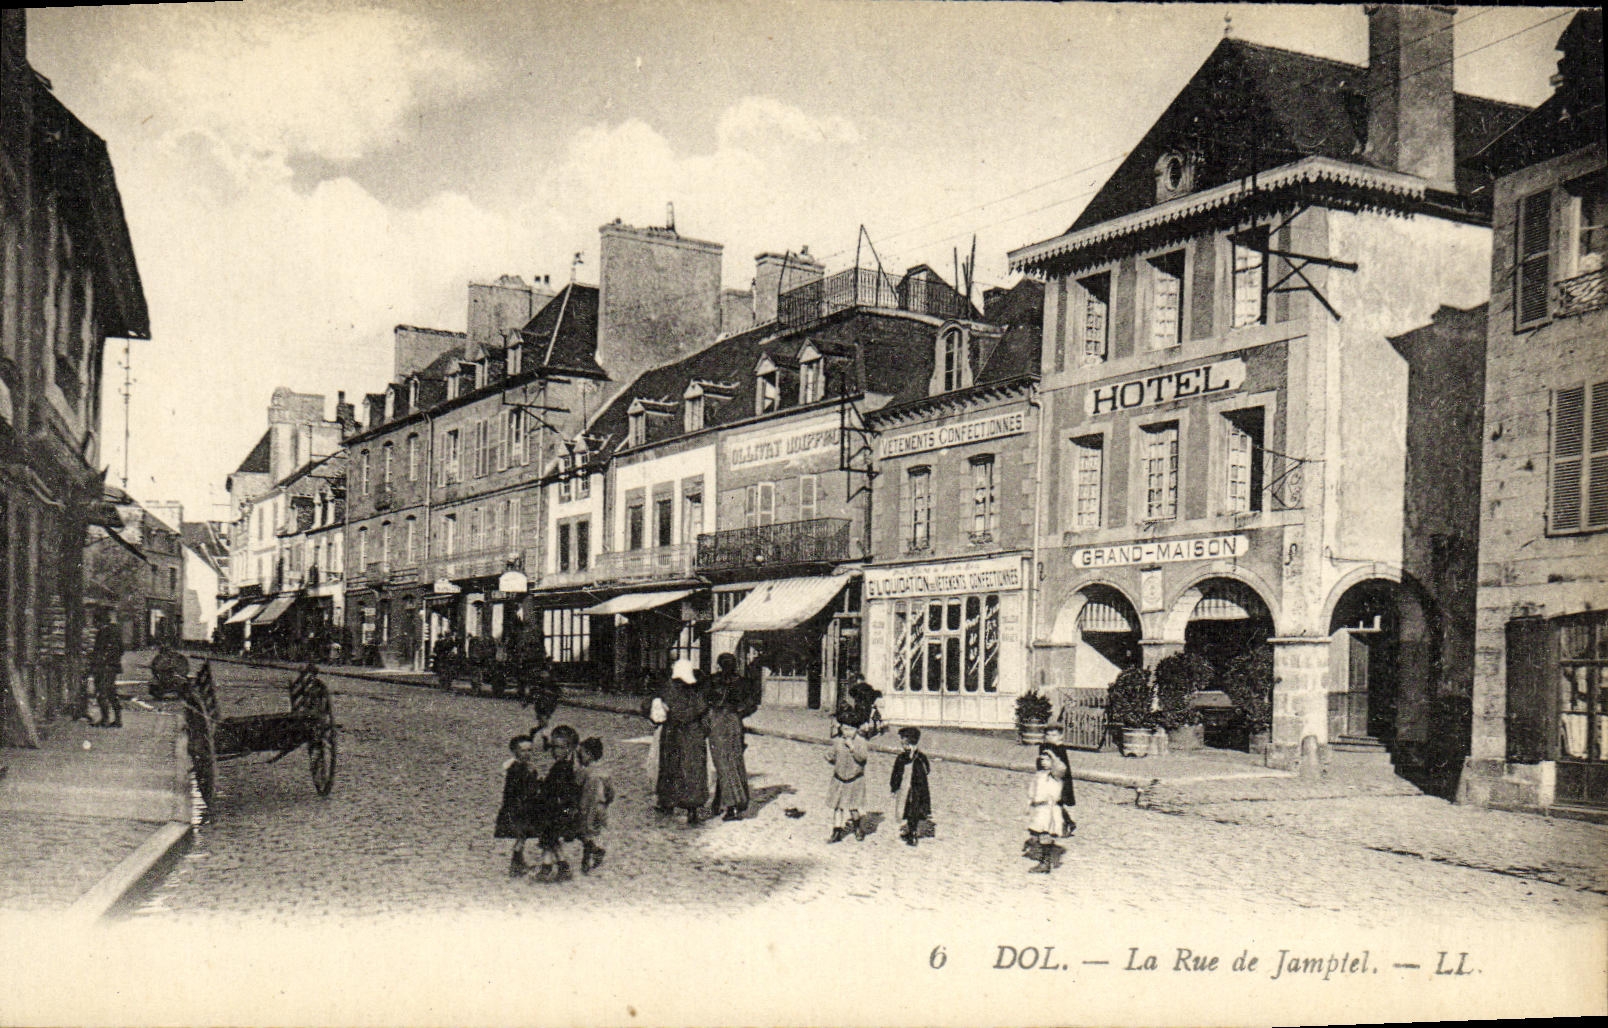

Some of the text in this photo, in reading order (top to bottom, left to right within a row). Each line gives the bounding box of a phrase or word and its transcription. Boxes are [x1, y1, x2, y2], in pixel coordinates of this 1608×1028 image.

[1092, 366, 1230, 415] HOTEL
[881, 414, 1023, 456] VETEMENTS CONFECTIONNES
[1081, 537, 1237, 567] GRAND-MAISON
